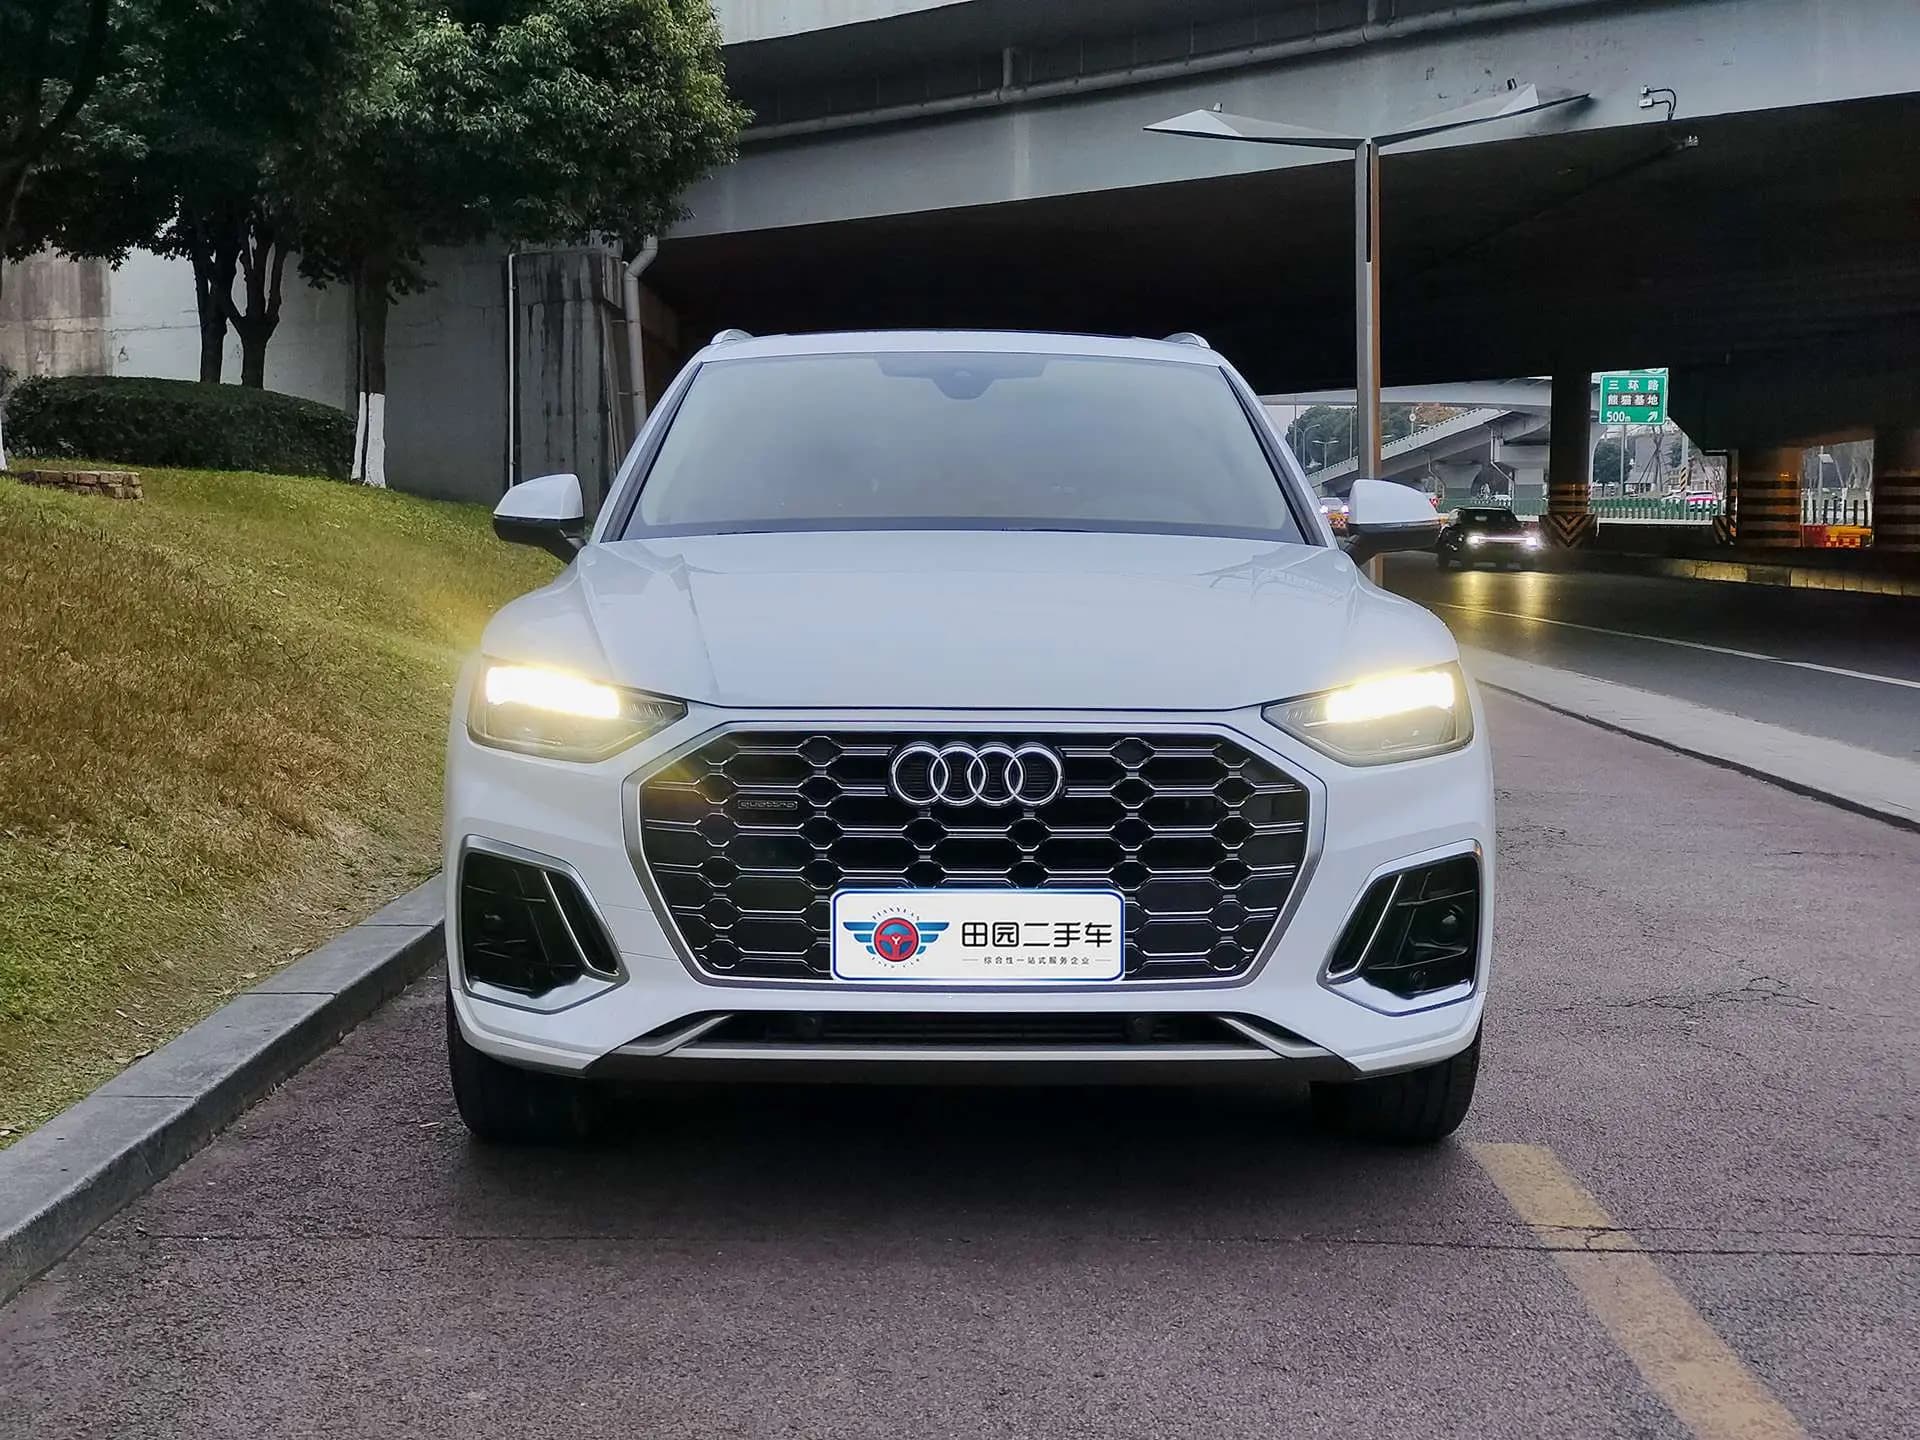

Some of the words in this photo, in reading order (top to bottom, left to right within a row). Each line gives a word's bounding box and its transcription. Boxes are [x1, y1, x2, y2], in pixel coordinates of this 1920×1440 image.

[1608, 380, 1659, 391] 三环路
[961, 922, 1113, 948] 田园二手车
[983, 956, 1091, 965] 综合性一站式服务企业
